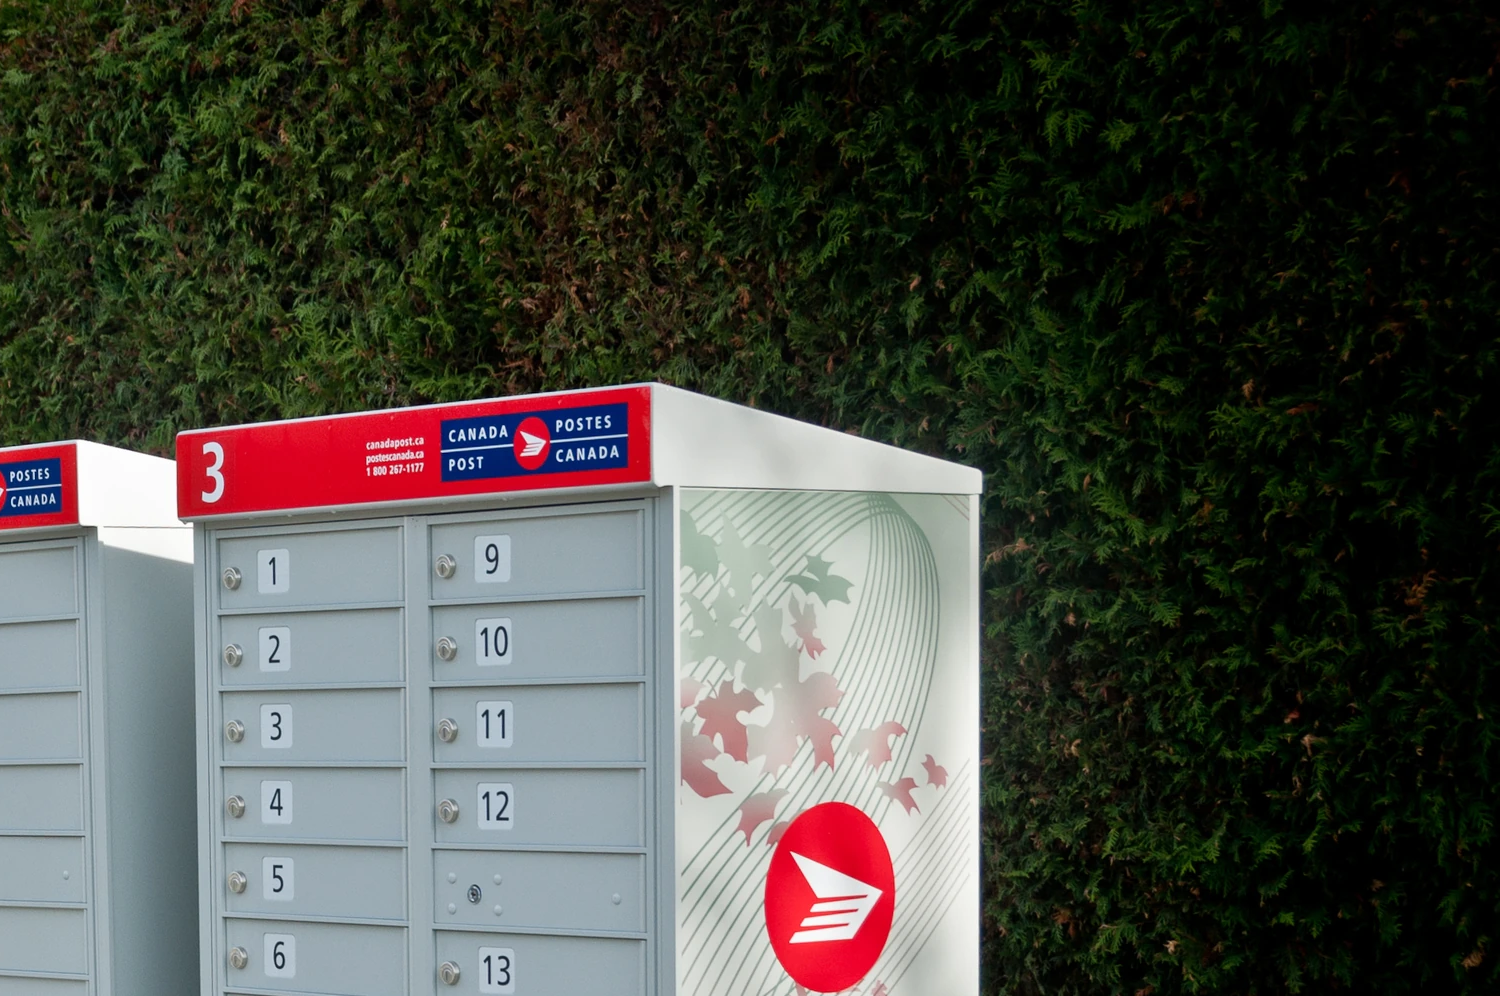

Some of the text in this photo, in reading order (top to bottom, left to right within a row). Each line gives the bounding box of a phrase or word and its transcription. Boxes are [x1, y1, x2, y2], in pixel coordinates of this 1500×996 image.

[449, 425, 508, 442] CANADA
[556, 415, 612, 432] POSTES
[366, 436, 424, 450] canadapost.ca
[366, 451, 424, 465] postescanada.ca
[556, 445, 619, 462] CANADA
[10, 468, 50, 482] POSTES
[201, 441, 225, 504] 3
[366, 462, 424, 477] 1 800 267-1177
[449, 457, 484, 471] POST
[11, 493, 56, 507] CANADA
[268, 556, 277, 586] 1
[485, 543, 499, 575] 9
[268, 634, 281, 664] 2
[480, 625, 509, 658] 10
[270, 711, 282, 741] 3
[481, 708, 506, 740] 11
[269, 787, 284, 817] 4
[481, 790, 510, 822] 12
[272, 864, 284, 893] 5
[273, 940, 286, 970] 6
[483, 955, 511, 986] 13
